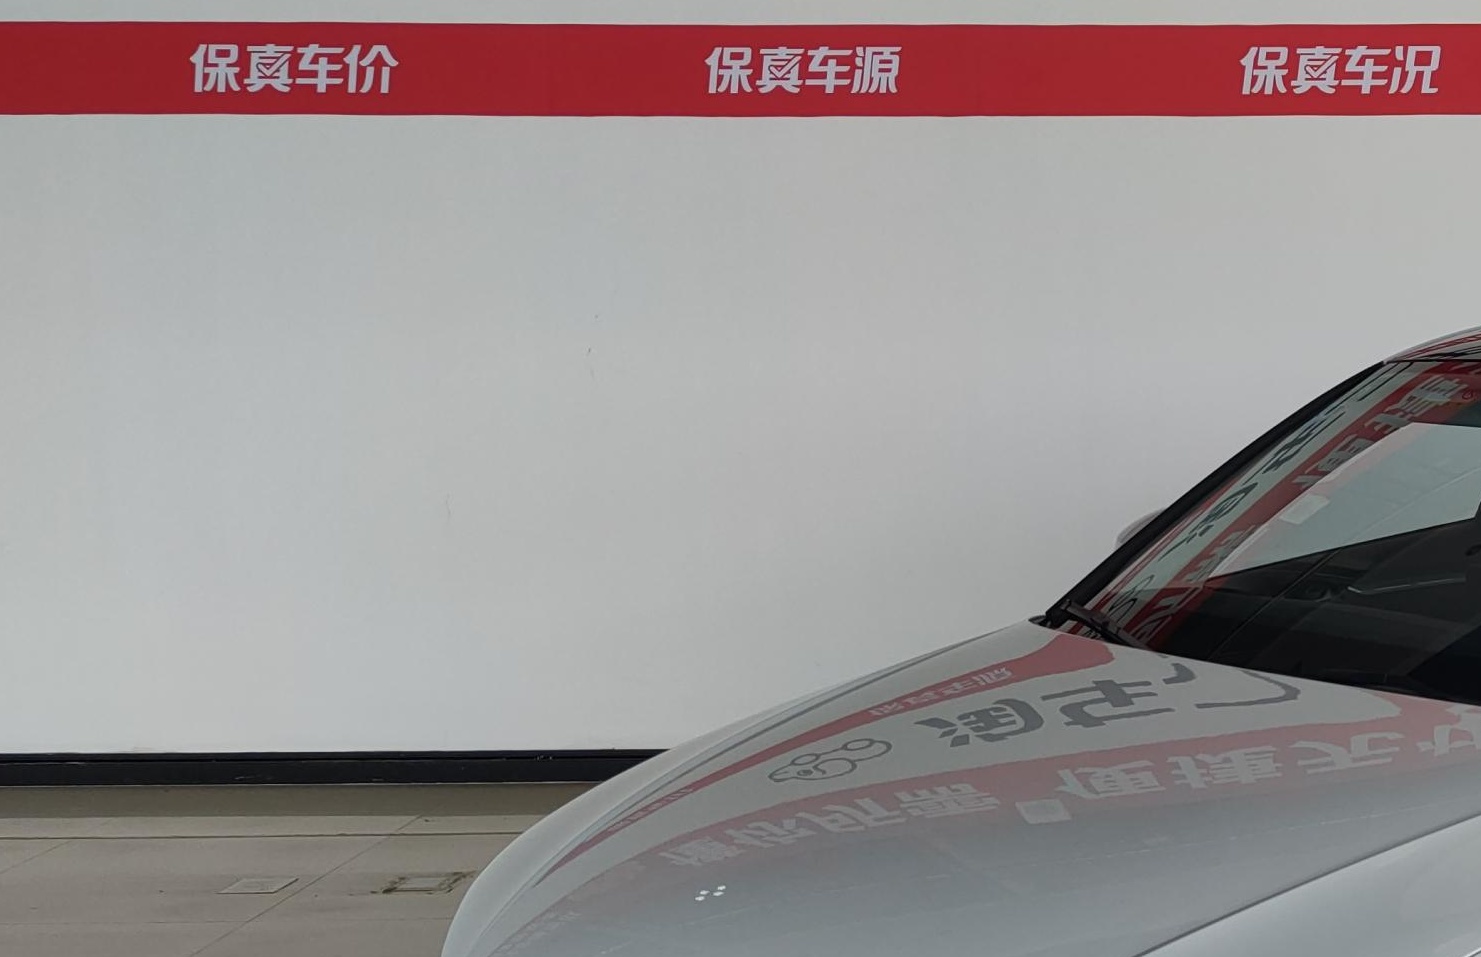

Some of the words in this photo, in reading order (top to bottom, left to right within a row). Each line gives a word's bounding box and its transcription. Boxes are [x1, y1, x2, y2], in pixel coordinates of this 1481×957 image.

[190, 44, 398, 93] 保真车价
[705, 47, 901, 93] 保真车源
[1240, 46, 1441, 94] 保真车况
